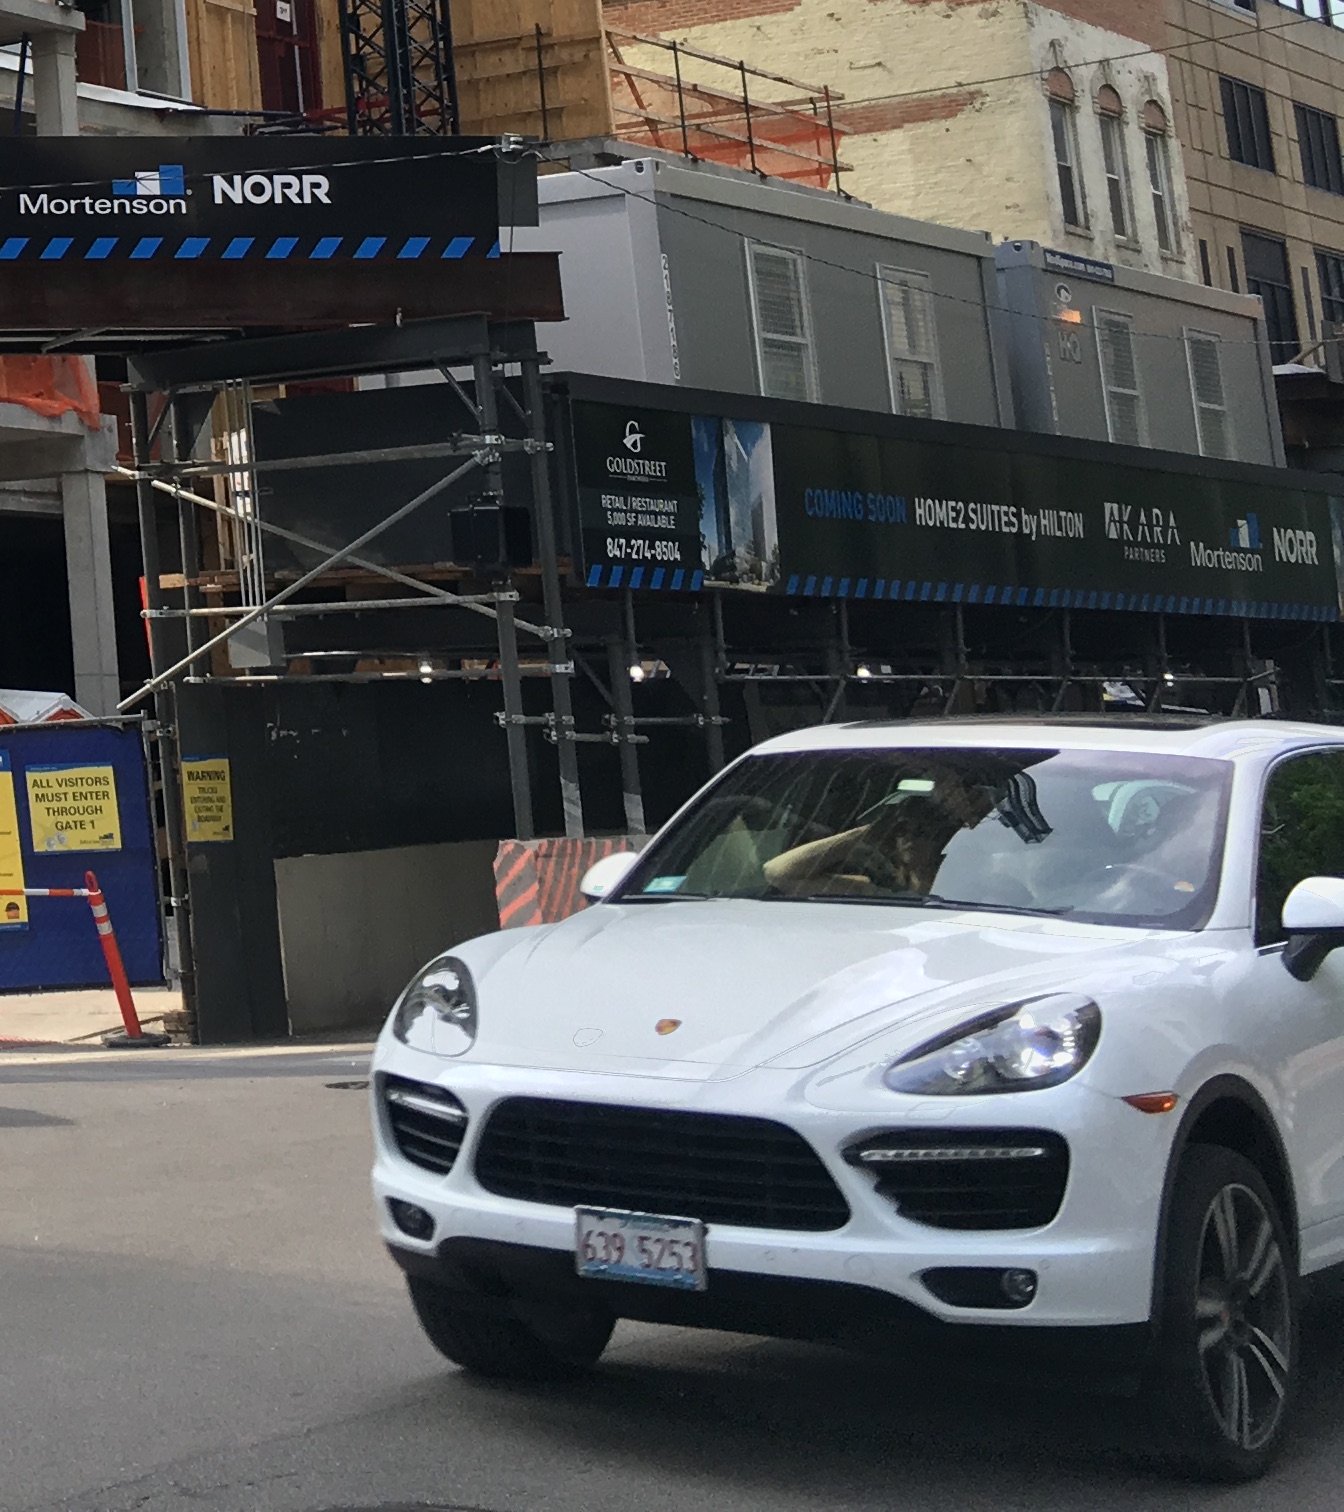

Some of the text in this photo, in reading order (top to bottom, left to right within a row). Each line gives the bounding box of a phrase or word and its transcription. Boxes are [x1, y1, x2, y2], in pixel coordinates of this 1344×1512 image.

[213, 174, 332, 205] NORR
[19, 193, 188, 216] Mortenson
[606, 456, 667, 477] GOLDSTREET
[601, 494, 628, 510] RETAIL
[631, 496, 677, 514] RESTAURANT
[804, 488, 1085, 541] COMING SOON HOME2 SUITES by HILTON
[607, 511, 676, 529] 5,000 SF AVAILABLE
[606, 537, 681, 562] 847-274-8504
[1123, 546, 1167, 564] PARTNERS
[1189, 540, 1263, 572] Mortenson
[1272, 526, 1319, 566] NORR
[31, 776, 110, 789] ALL VISITORS
[34, 790, 110, 803] MUST ENTER
[44, 804, 104, 817] THROUGH
[54, 819, 96, 831] GATE 1
[581, 1229, 699, 1274] 639 5253
